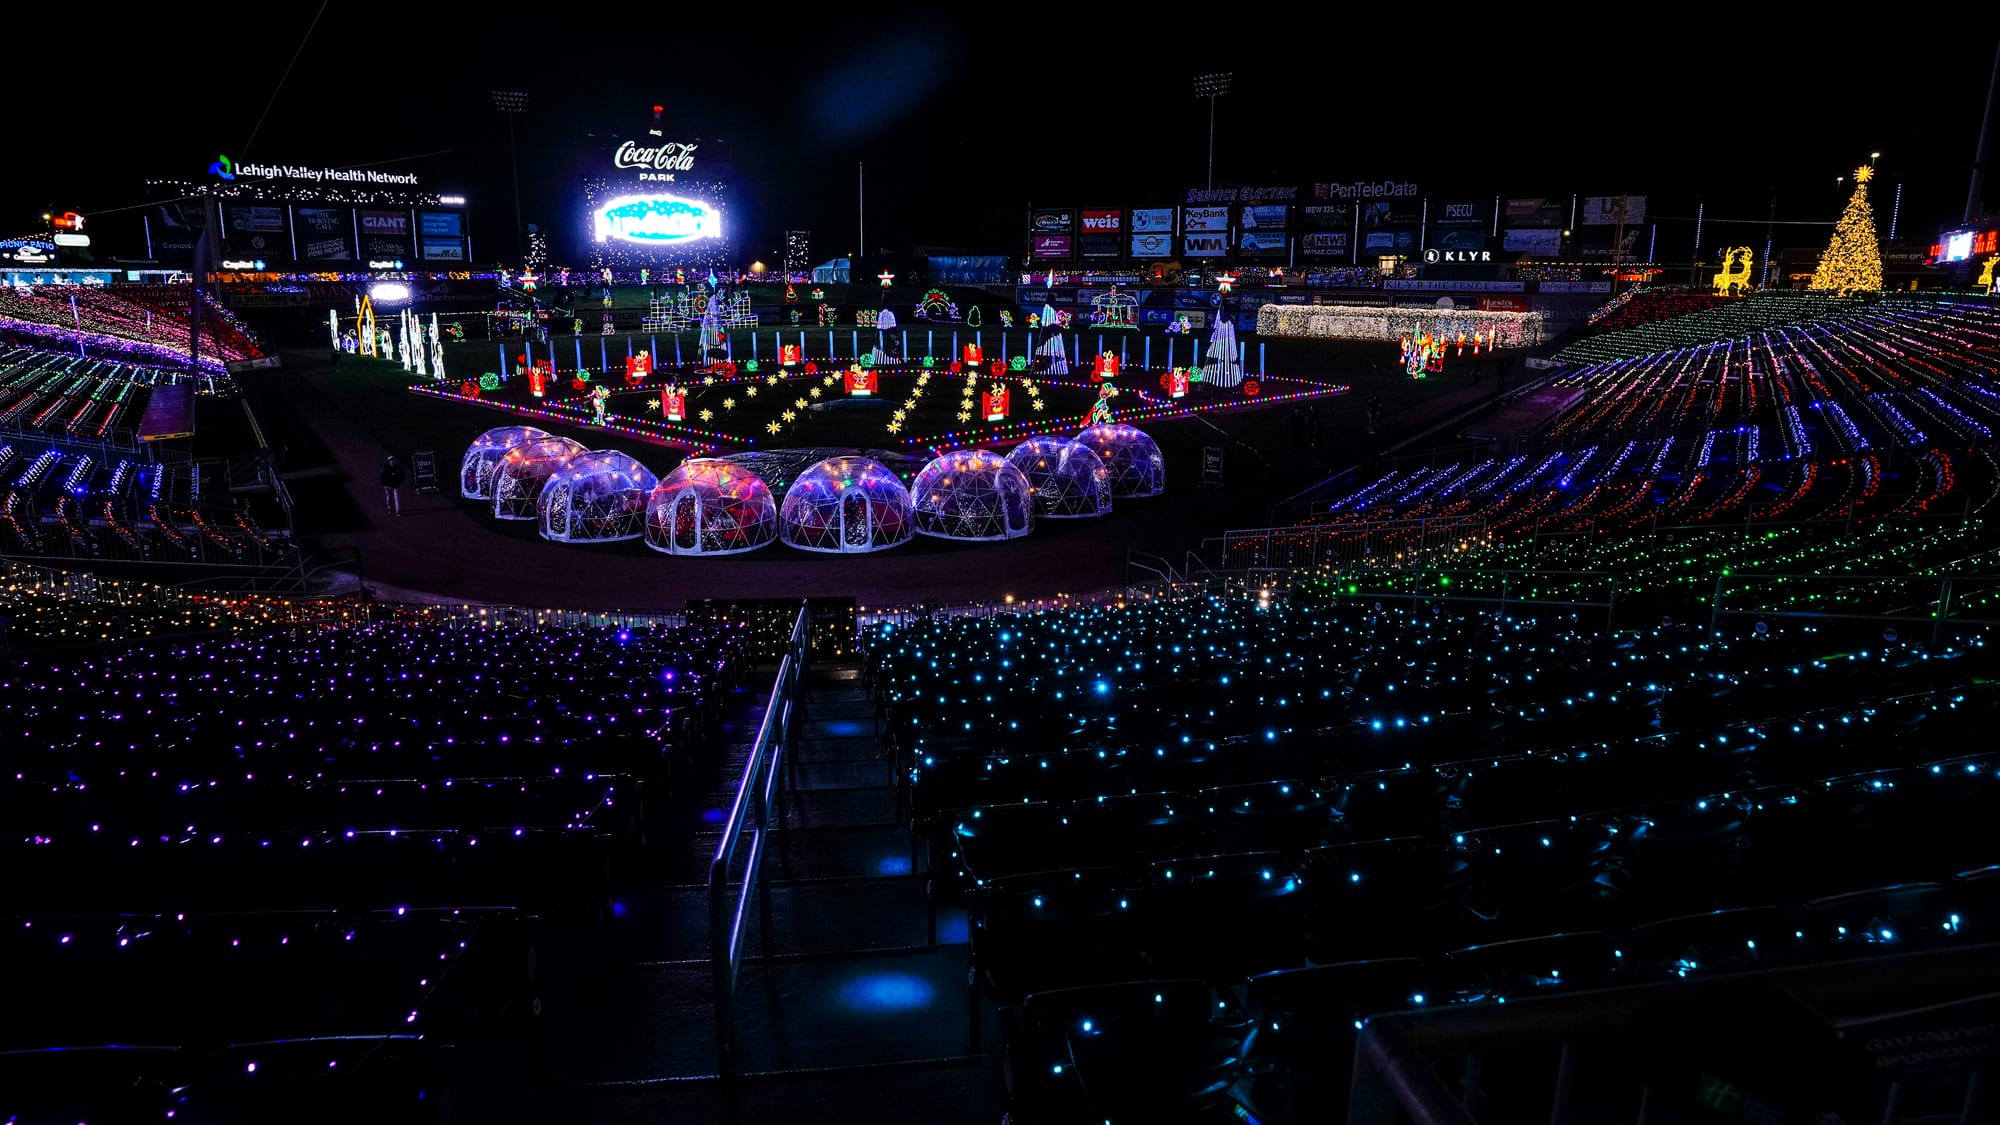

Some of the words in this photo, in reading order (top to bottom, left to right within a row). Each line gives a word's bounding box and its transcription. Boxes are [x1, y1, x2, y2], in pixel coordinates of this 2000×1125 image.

[614, 140, 698, 171] Coca-Cola
[234, 162, 282, 180] Lehigh
[283, 165, 322, 181] Valley
[324, 167, 366, 182] Health
[367, 170, 418, 185] Network
[639, 173, 675, 182] PARK
[1330, 180, 1418, 198] PenTeleData
[1188, 209, 1226, 219] KeyBank
[1446, 204, 1473, 217] PSECU
[362, 216, 407, 228] GIANT
[1082, 214, 1120, 229] weis
[0, 240, 28, 248] PICNIC
[30, 240, 55, 250] PATIO
[1186, 239, 1223, 250] WM
[1315, 234, 1346, 246] NEWS
[1445, 251, 1492, 262] KLYR
[369, 260, 395, 270] Capital
